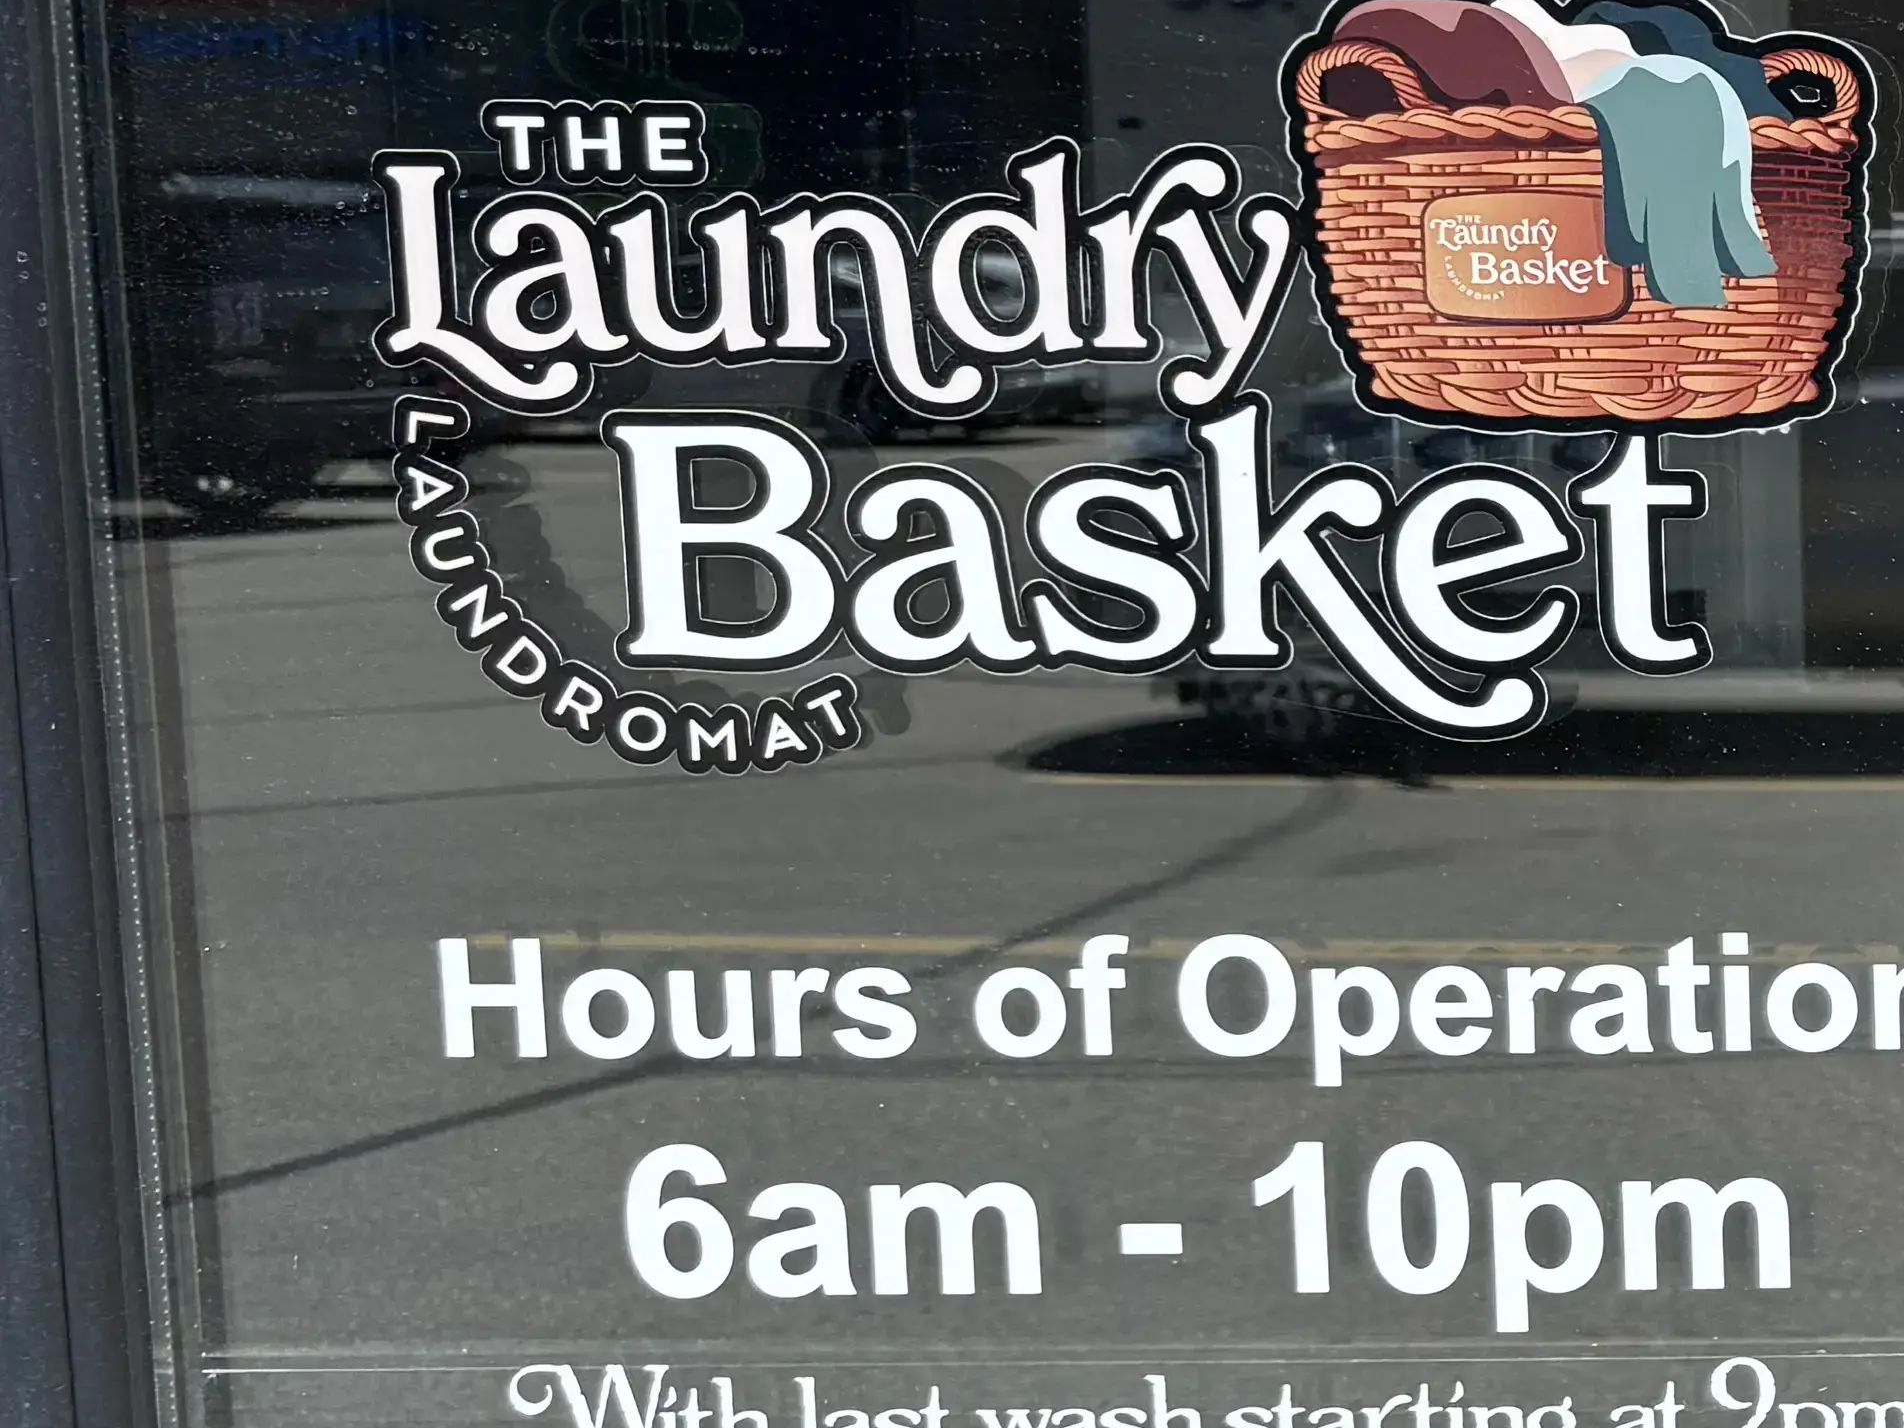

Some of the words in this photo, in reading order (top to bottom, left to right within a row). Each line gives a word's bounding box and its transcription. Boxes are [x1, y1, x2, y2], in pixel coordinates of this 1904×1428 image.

[496, 115, 693, 171] THE
[1430, 218, 1558, 252] Laundry
[1456, 214, 1482, 223] THE
[387, 153, 1290, 404] Laundry
[1444, 256, 1505, 300] LAUNDROMAT
[1470, 251, 1609, 293] Basket
[407, 410, 846, 762] LAUNDROMAT
[616, 406, 1697, 726] Basket
[439, 937, 917, 1059] Hours
[974, 934, 1130, 1057] of
[626, 1143, 1042, 1299] 6am
[1120, 1223, 1183, 1255] -
[1253, 1140, 1791, 1333] 10pm
